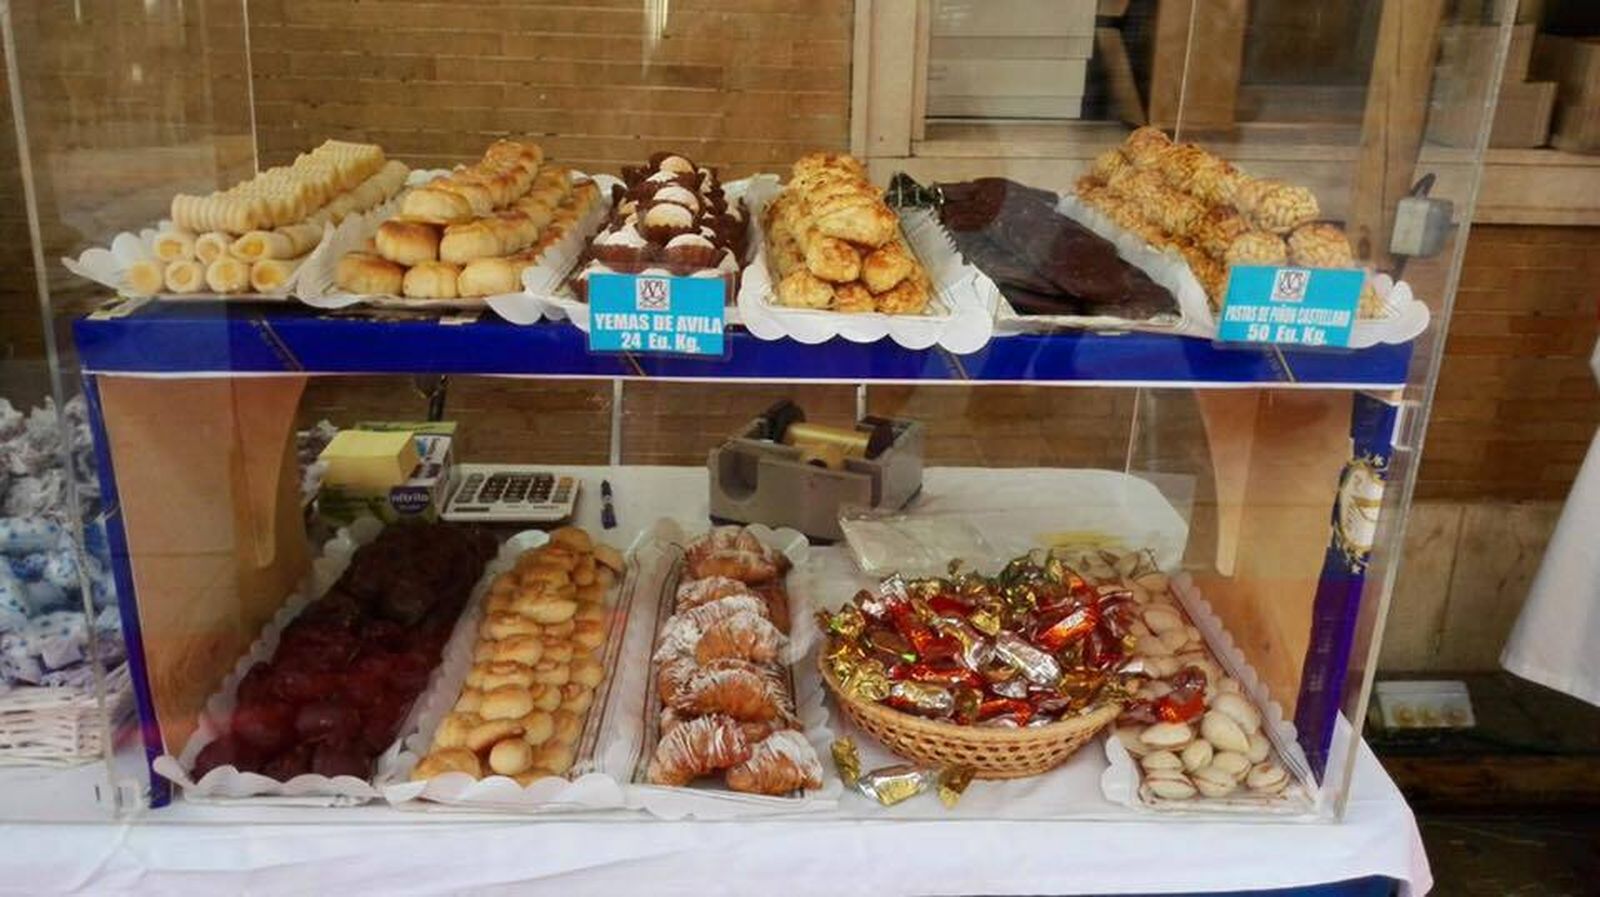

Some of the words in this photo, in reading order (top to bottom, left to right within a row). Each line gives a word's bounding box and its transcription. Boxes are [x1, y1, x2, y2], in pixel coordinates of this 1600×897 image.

[594, 313, 650, 331] YEMAS
[653, 315, 674, 332] DE
[676, 315, 723, 334] AVILA
[1224, 304, 1257, 322] PASTAS
[1257, 306, 1271, 323] DE
[1297, 307, 1351, 328] CASTELLANO
[620, 332, 641, 349] 24
[648, 332, 672, 350] Eu.
[675, 333, 701, 354] Kg.
[1246, 323, 1270, 341] 50
[1275, 325, 1300, 343] Eu.
[1301, 326, 1328, 346] Kg.
